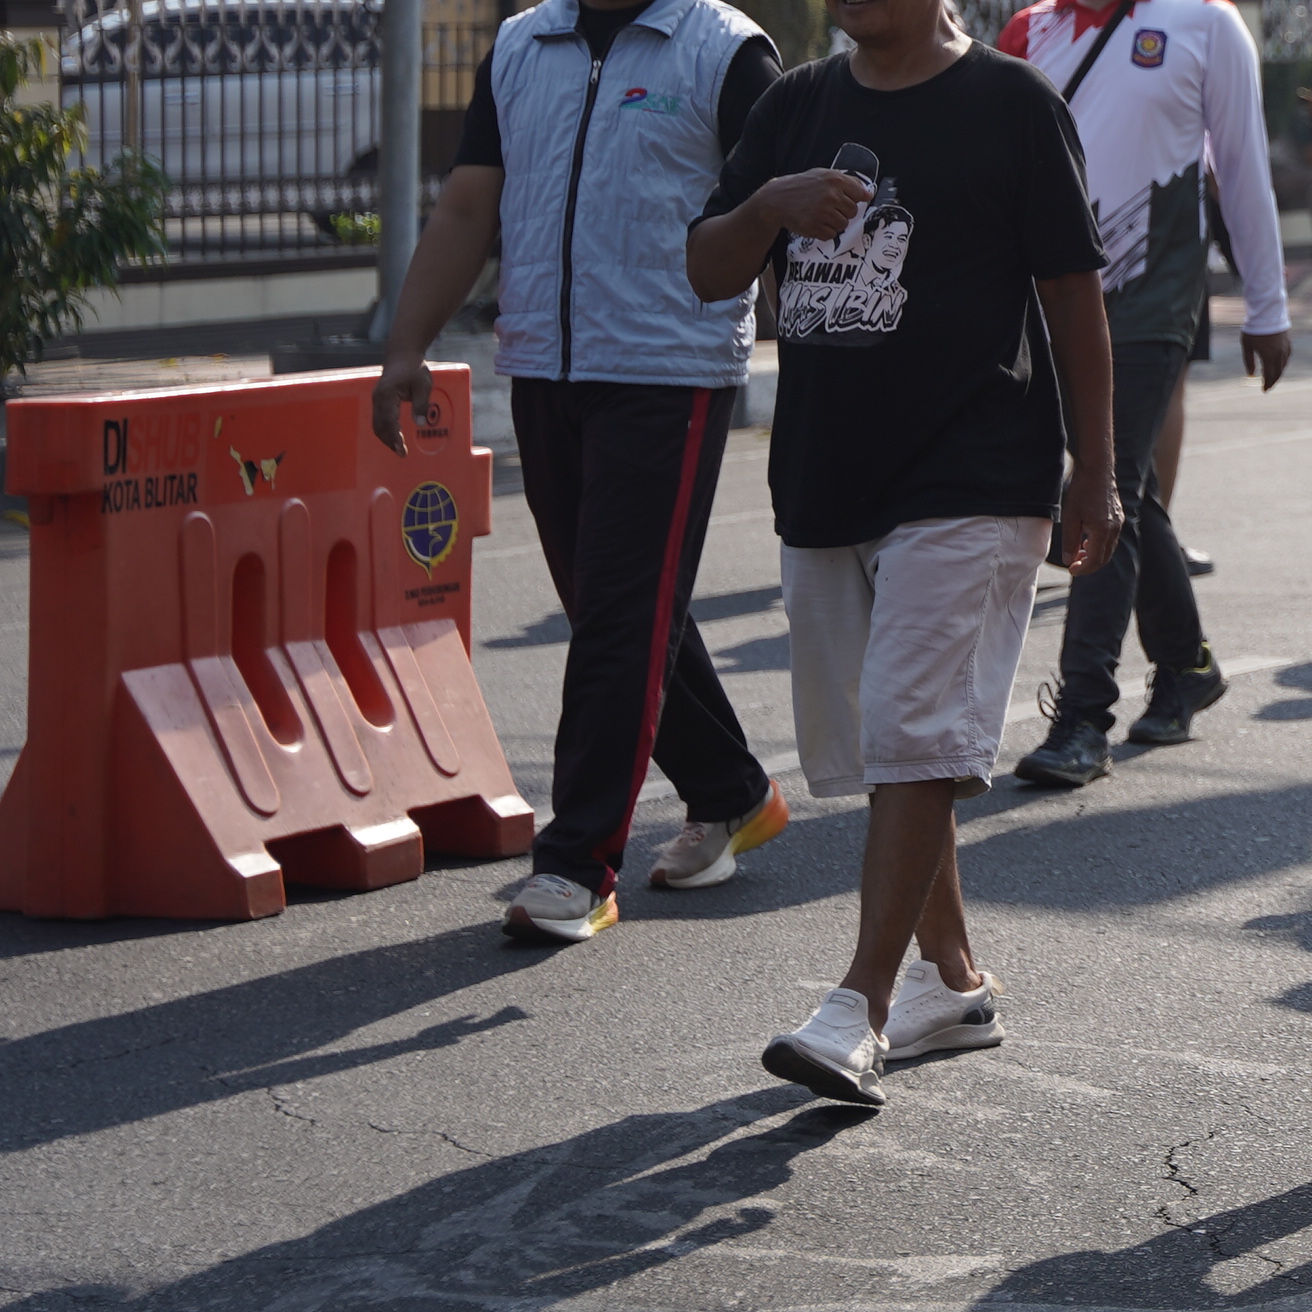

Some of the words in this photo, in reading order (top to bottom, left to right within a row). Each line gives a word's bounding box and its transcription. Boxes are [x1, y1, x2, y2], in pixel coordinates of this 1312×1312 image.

[787, 261, 857, 285] RELAWAN
[779, 283, 832, 338] MAS
[103, 412, 201, 476] DISHUB
[102, 479, 141, 514] KOTA
[145, 472, 198, 508] BLITAR
